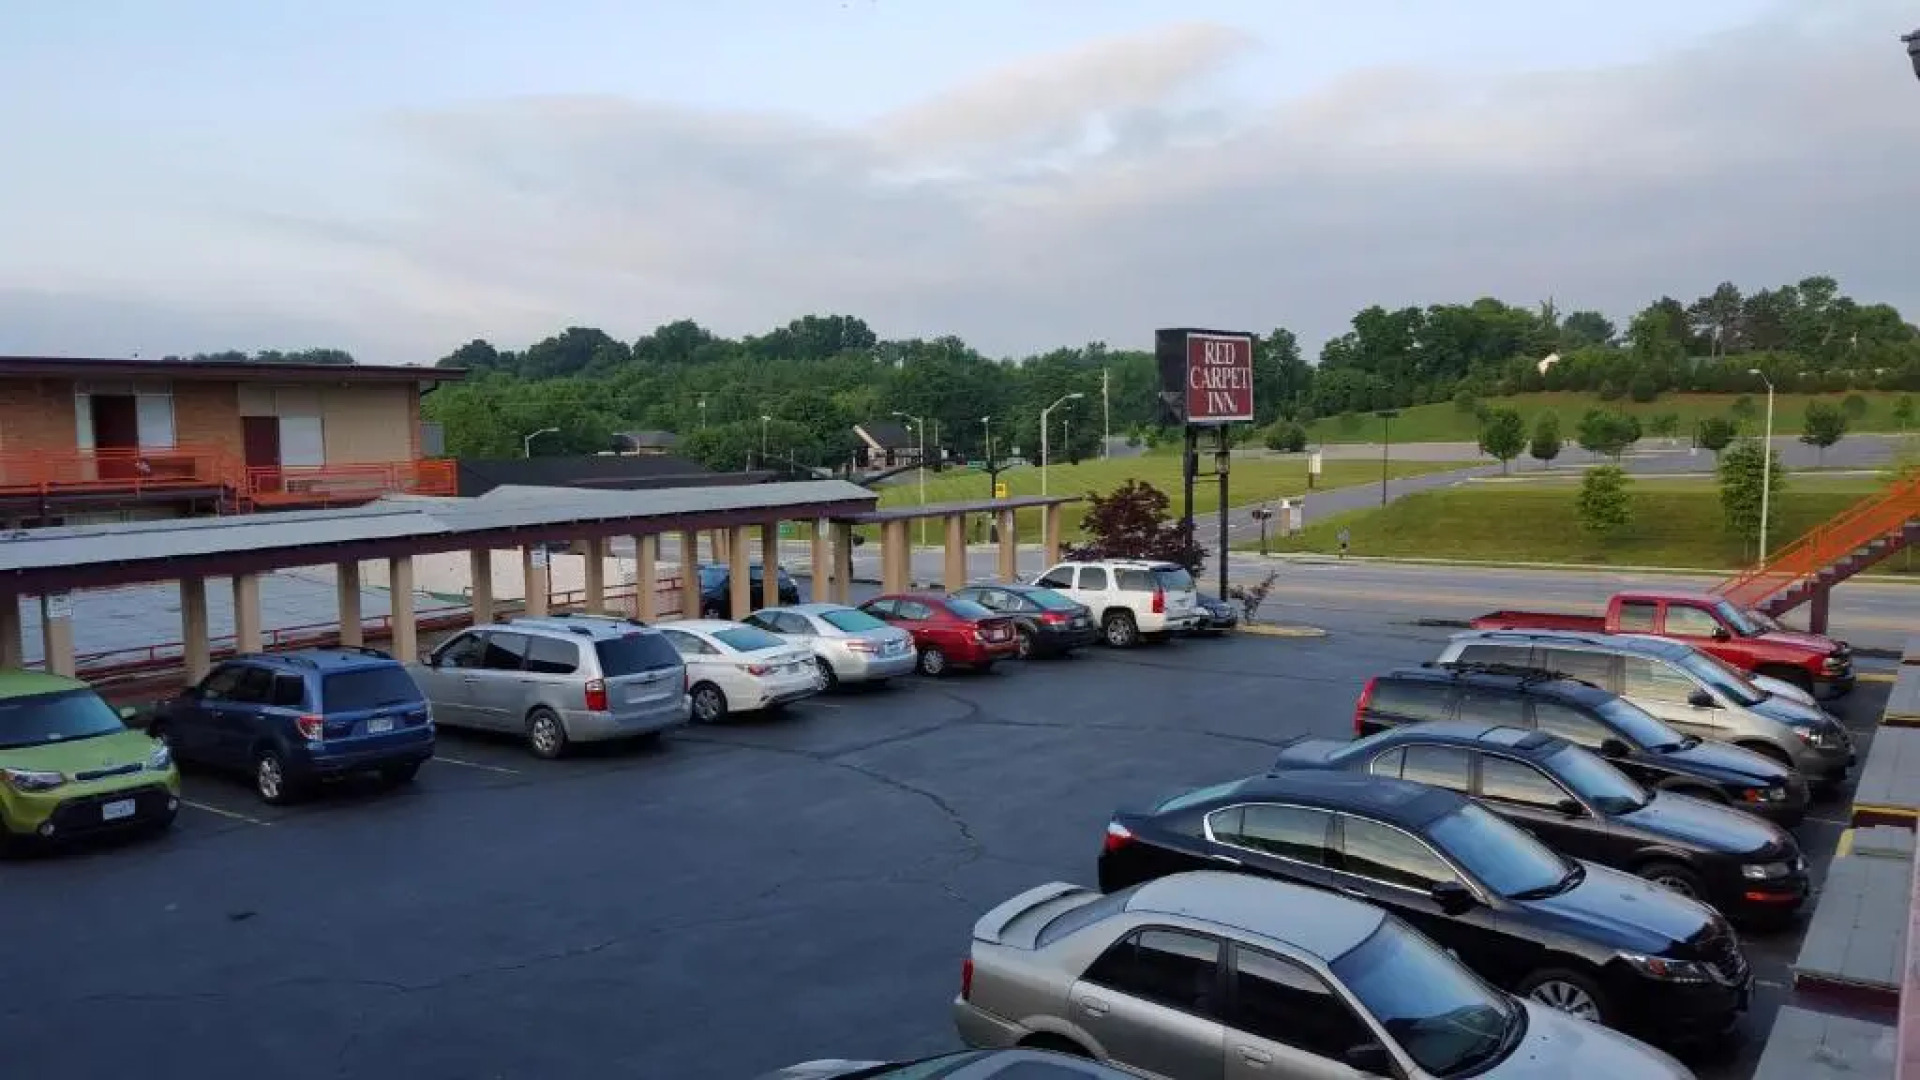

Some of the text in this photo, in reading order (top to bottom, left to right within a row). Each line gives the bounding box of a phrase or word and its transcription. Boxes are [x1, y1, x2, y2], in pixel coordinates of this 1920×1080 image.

[1205, 341, 1236, 364] RED
[1190, 366, 1249, 389] CARPET
[1208, 391, 1238, 414] INN
